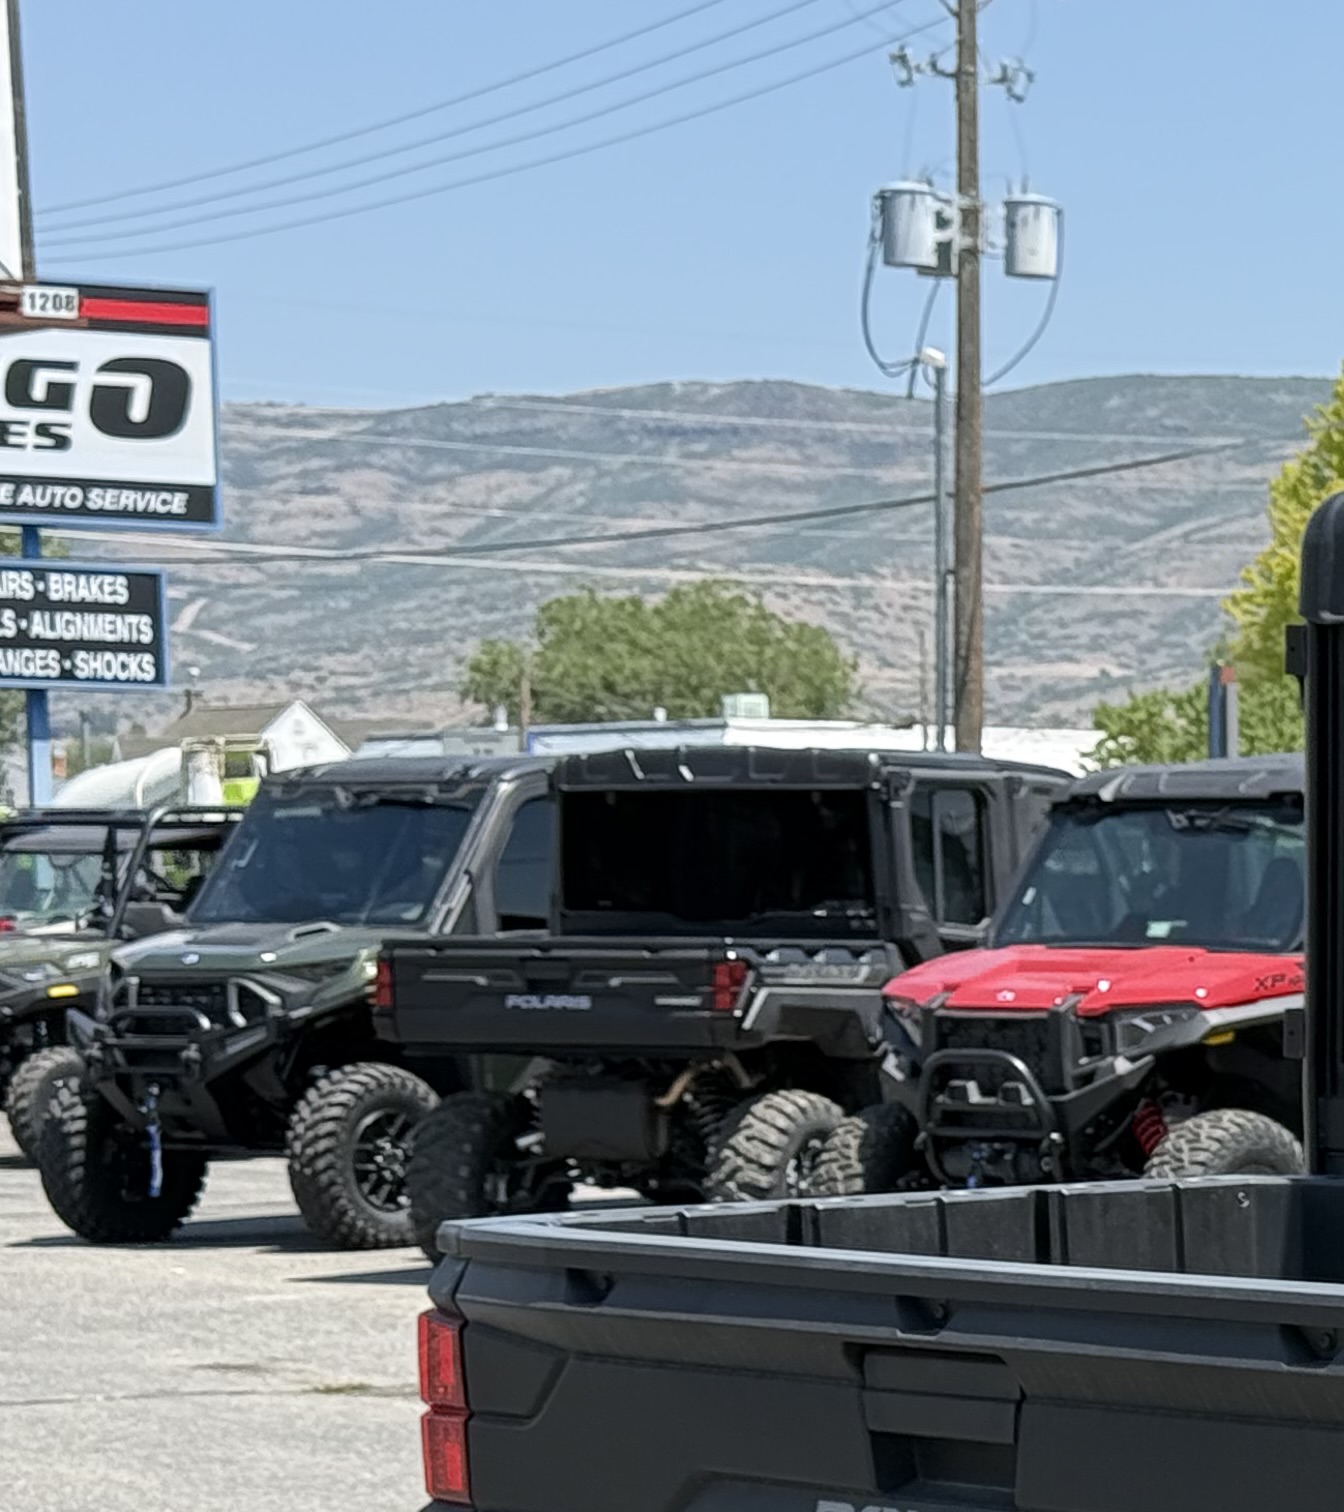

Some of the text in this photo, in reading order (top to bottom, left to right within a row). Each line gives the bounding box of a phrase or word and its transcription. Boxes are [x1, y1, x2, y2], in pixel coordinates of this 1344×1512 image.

[16, 485, 84, 509] AUTO
[86, 487, 189, 515] SERVICE
[0, 570, 130, 605] IRS BRAKES
[27, 610, 154, 645] ALIGNMENTS
[72, 650, 156, 682] SHOCKS
